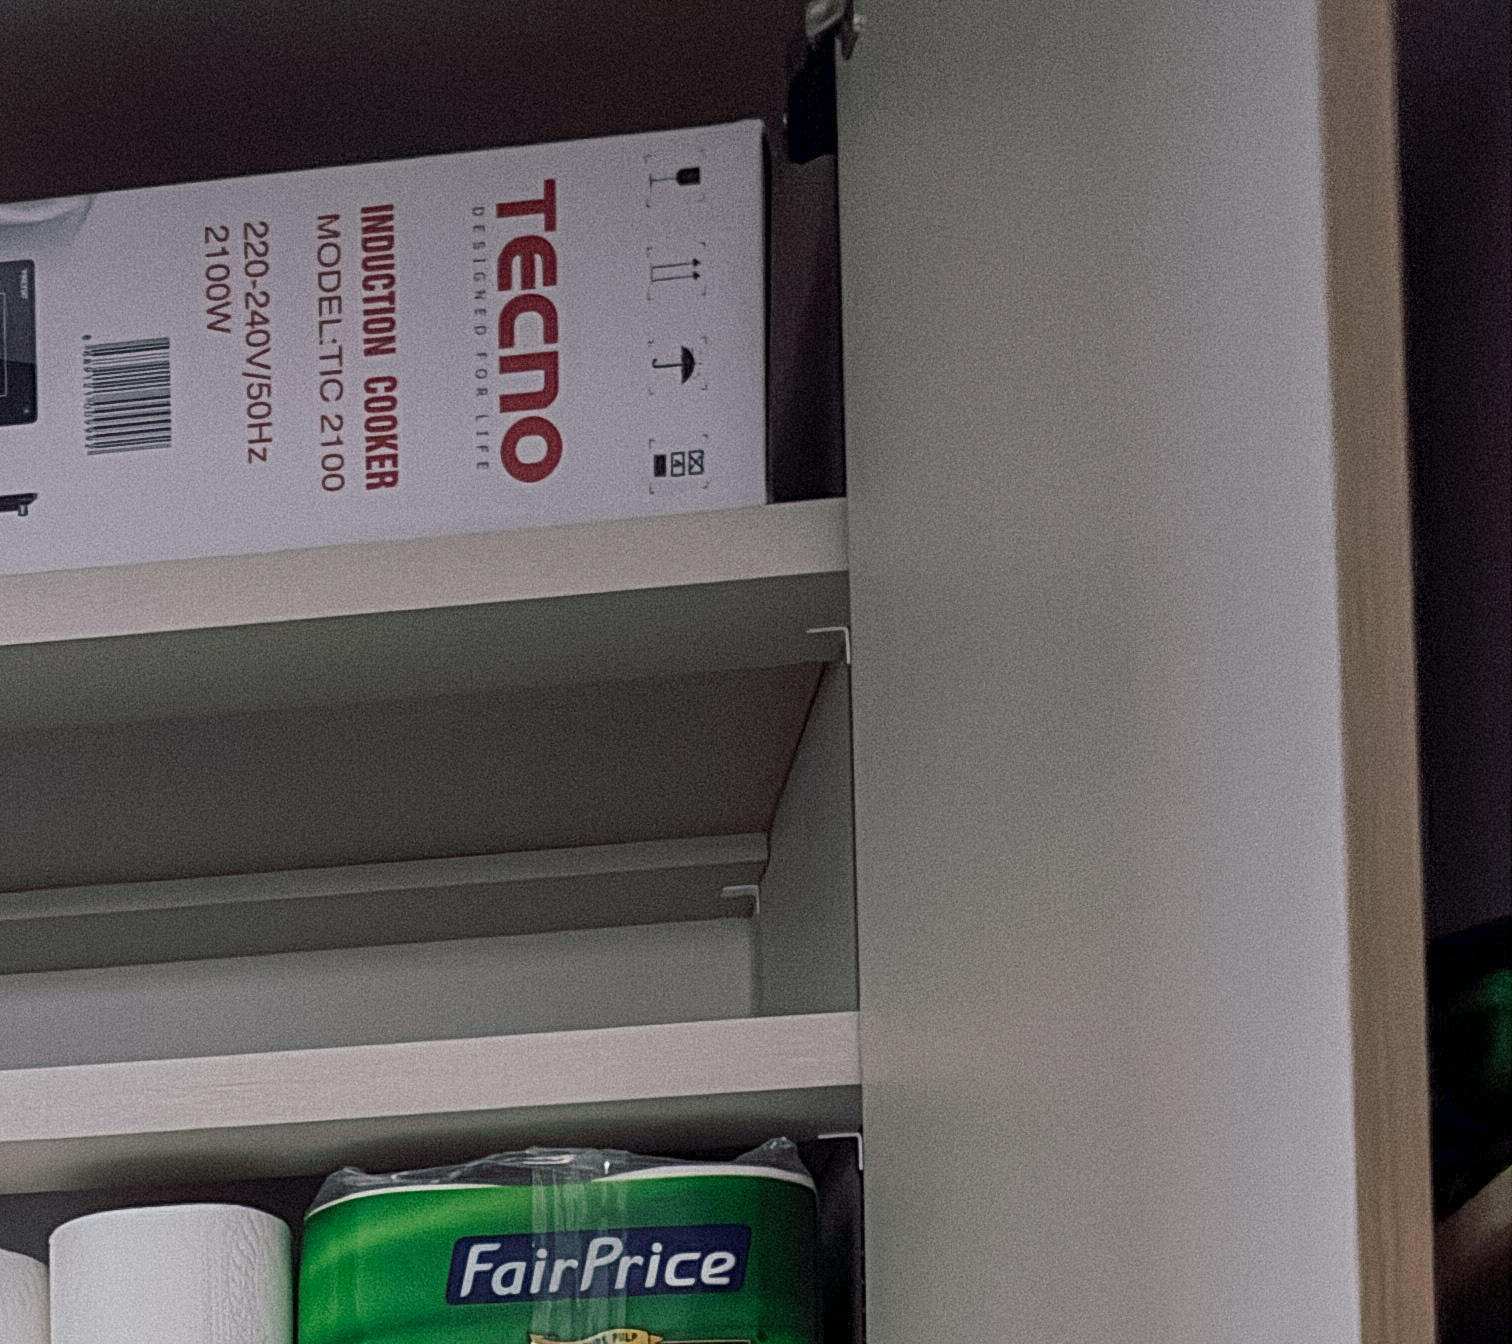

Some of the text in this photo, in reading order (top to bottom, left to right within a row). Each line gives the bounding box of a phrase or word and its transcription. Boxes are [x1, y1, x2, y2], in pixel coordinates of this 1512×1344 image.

[203, 224, 231, 334] 2100W
[241, 221, 274, 464] 220-240V/50Hz
[316, 213, 346, 492] MODEL:TIC 2100
[360, 203, 399, 490] INDUCTION COOKER
[471, 206, 489, 470] DESIGNED FOR LIFE
[495, 178, 563, 483] TECNO
[459, 1236, 737, 1299] FairPrice
